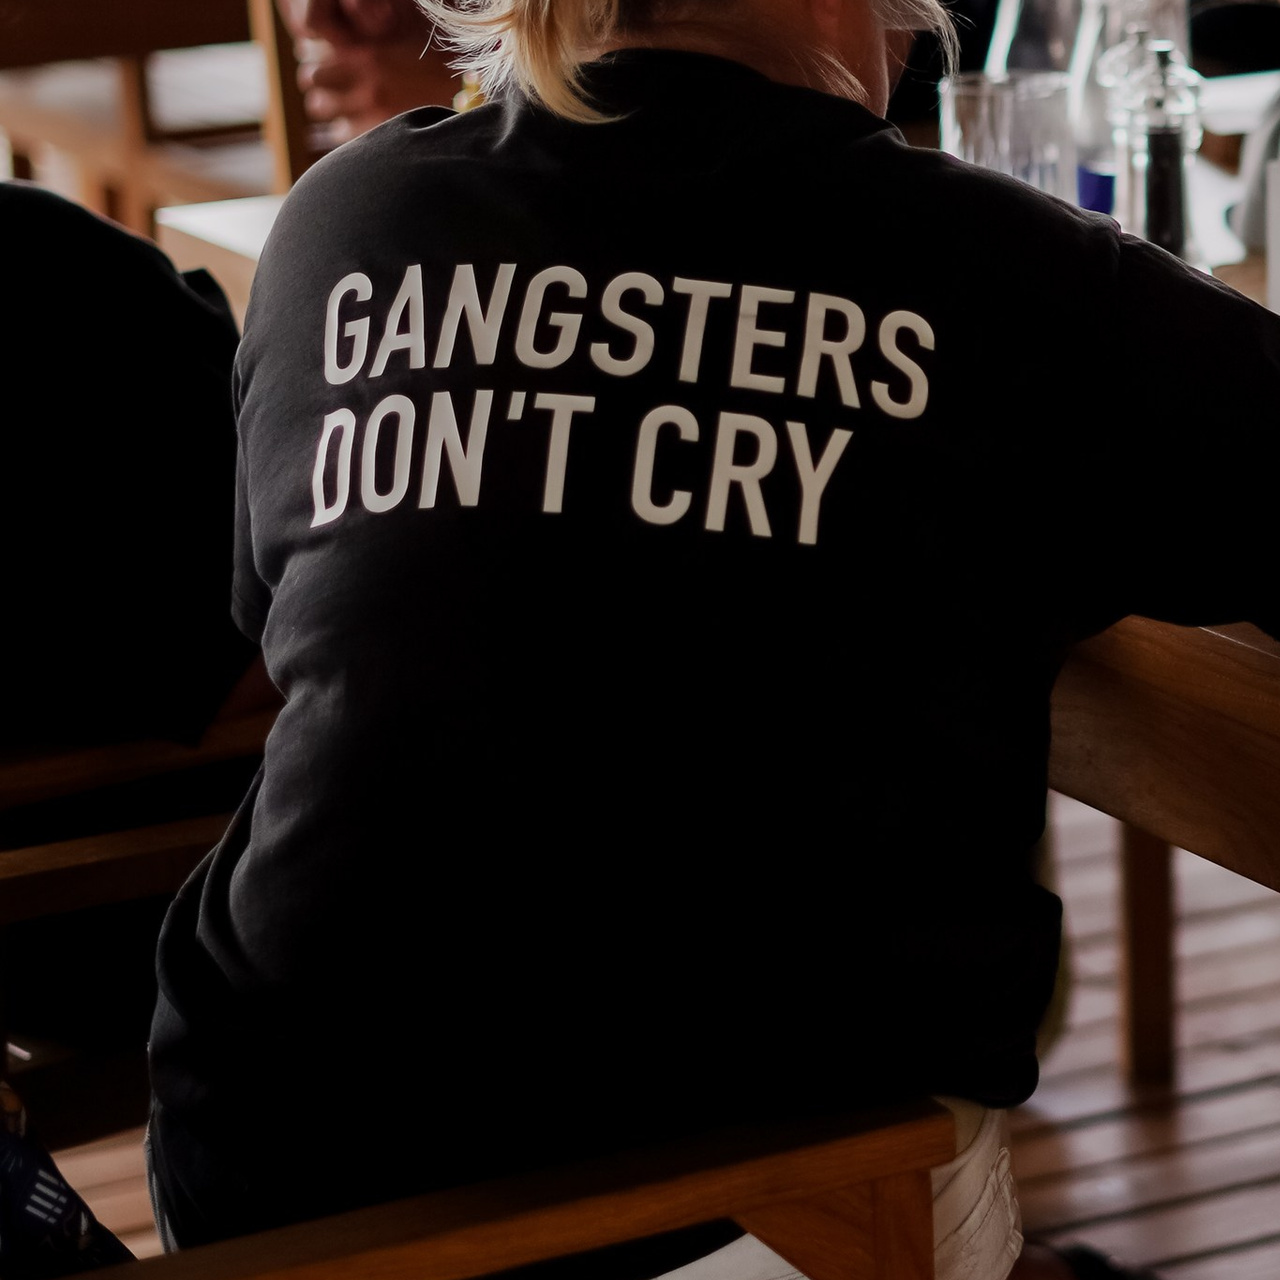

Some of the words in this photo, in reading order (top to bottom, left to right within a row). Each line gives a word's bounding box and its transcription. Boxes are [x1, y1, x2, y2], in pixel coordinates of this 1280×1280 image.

[323, 263, 935, 419] GANGSTERS
[309, 389, 596, 529] DON'T
[631, 404, 854, 545] CRY
